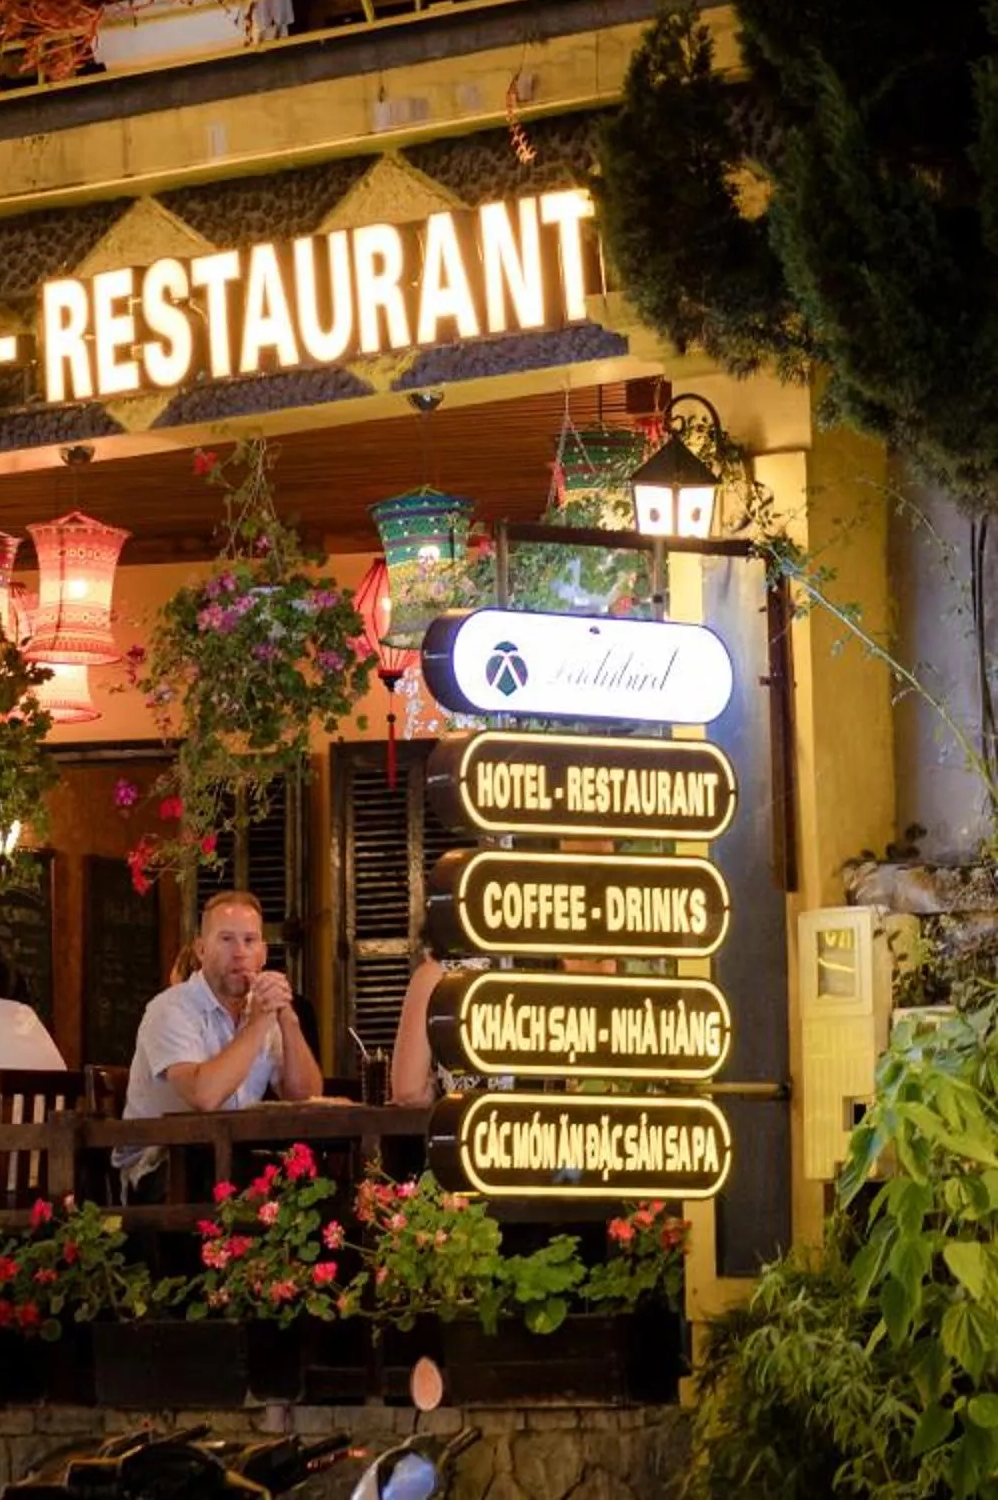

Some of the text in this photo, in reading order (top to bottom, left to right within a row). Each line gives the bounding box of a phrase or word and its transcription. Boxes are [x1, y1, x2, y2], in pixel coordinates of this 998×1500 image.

[44, 188, 594, 401] RESTAURANT
[477, 762, 552, 810] HOTEL
[567, 766, 718, 817] RESTAURANT
[483, 881, 587, 930] COFFEE
[606, 886, 707, 934] DRINKS
[471, 993, 545, 1052] KHÁCH
